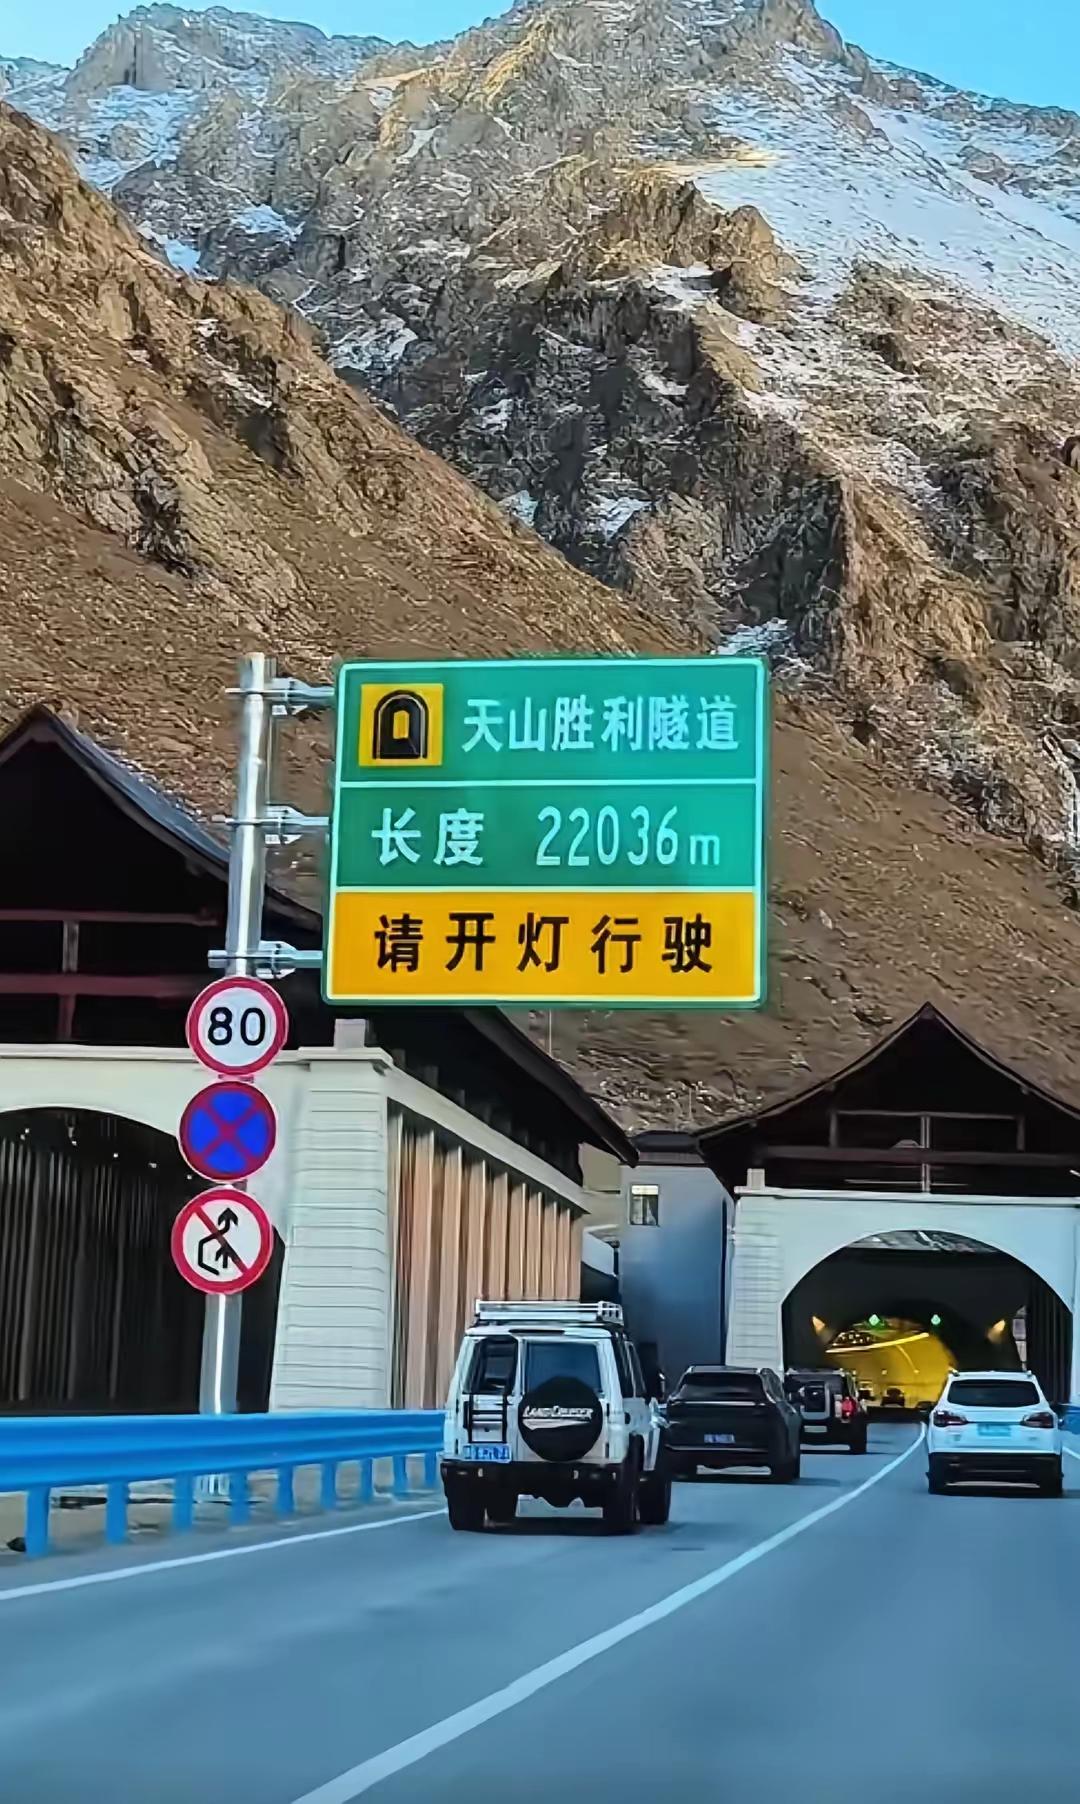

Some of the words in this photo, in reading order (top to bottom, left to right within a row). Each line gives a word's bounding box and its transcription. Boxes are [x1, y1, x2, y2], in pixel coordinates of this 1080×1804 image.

[461, 694, 739, 753] 天山胜利隧道
[371, 807, 485, 866] 长度
[373, 912, 713, 974] 请开灯行驶
[207, 1006, 267, 1046] 80
